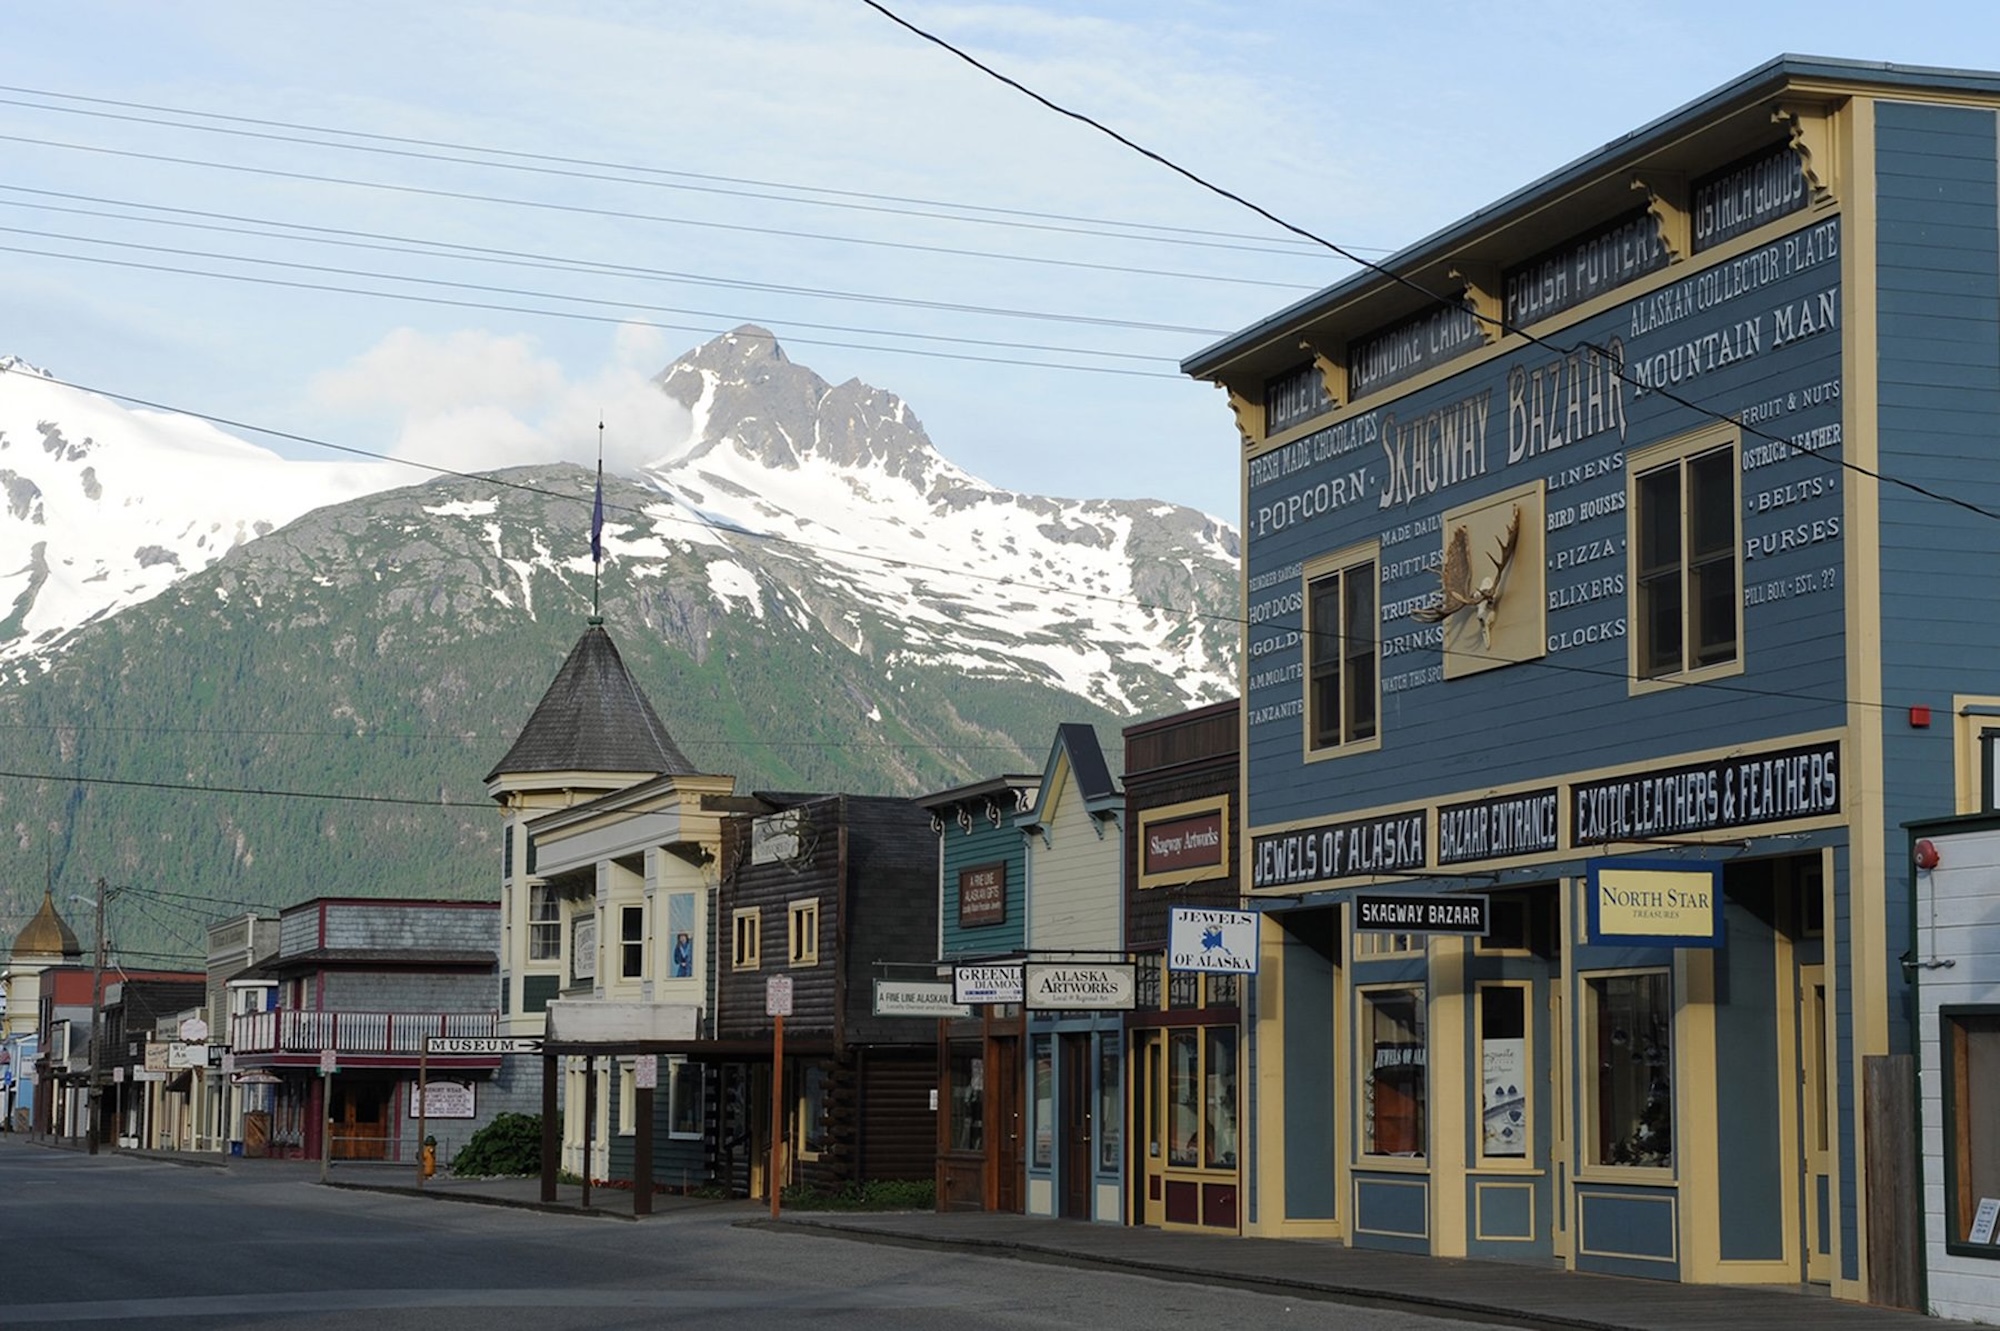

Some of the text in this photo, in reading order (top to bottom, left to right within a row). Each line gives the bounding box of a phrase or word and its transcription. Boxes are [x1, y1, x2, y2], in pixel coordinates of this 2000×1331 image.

[1696, 150, 1802, 240] OSTRICH GOODS
[1508, 260, 1567, 321] POLISH
[1630, 221, 1838, 338] ALASKAN COLLECTOR PLATE
[1351, 320, 1422, 390] KLONDIKE
[1634, 288, 1837, 397] MOUNTAIN MAN
[1742, 380, 1840, 427] FRUIT & NUTS
[1378, 334, 1628, 512] SKAGWAY BAZAAR
[1250, 412, 1379, 488] FRESH MADE CHOCOLATES
[1742, 423, 1841, 472] OSTRICH LEATHER
[1548, 452, 1624, 491] LINENS
[1258, 467, 1367, 537] POPCORN
[1547, 490, 1626, 532] BIRD HOUSES
[1758, 477, 1823, 511] BELTS
[1381, 525, 1411, 548] MADE
[1556, 538, 1615, 569] PIZZA
[1746, 517, 1839, 560] PURSES
[1382, 549, 1444, 582] BRITTLES
[1548, 574, 1625, 611] ELIXERS
[1744, 586, 1765, 608] PILL
[1767, 581, 1786, 600] BOX
[1253, 631, 1299, 657] GOLD
[1382, 626, 1444, 658] DRINKS
[1548, 618, 1626, 652] CLOCKS
[1249, 662, 1303, 690] AMMOLITE
[1381, 674, 1408, 693] WATCH
[1409, 669, 1426, 688] THIS
[1249, 699, 1304, 726] TANZANITE
[1578, 751, 1837, 838] EXOTIC LEATHERS & FEATHERS
[1151, 826, 1219, 857] Skagway Artworks
[1439, 794, 1557, 860] BAZAAR ENTRANCE
[1254, 816, 1423, 886] JEWELS OF ALASKA
[1362, 903, 1480, 926] SKAGWAY BAZAAR
[1602, 886, 1710, 909] NORTH STAR
[1632, 909, 1680, 920] TREASURES
[1178, 911, 1252, 925] JEWELS
[1052, 971, 1108, 982] ALASKA
[1175, 953, 1252, 971] OF ALASKA
[886, 992, 900, 1001] FINE
[901, 993, 916, 1002] LINE
[917, 993, 948, 1004] ALASKAN
[431, 1040, 515, 1051] MUSEUM
